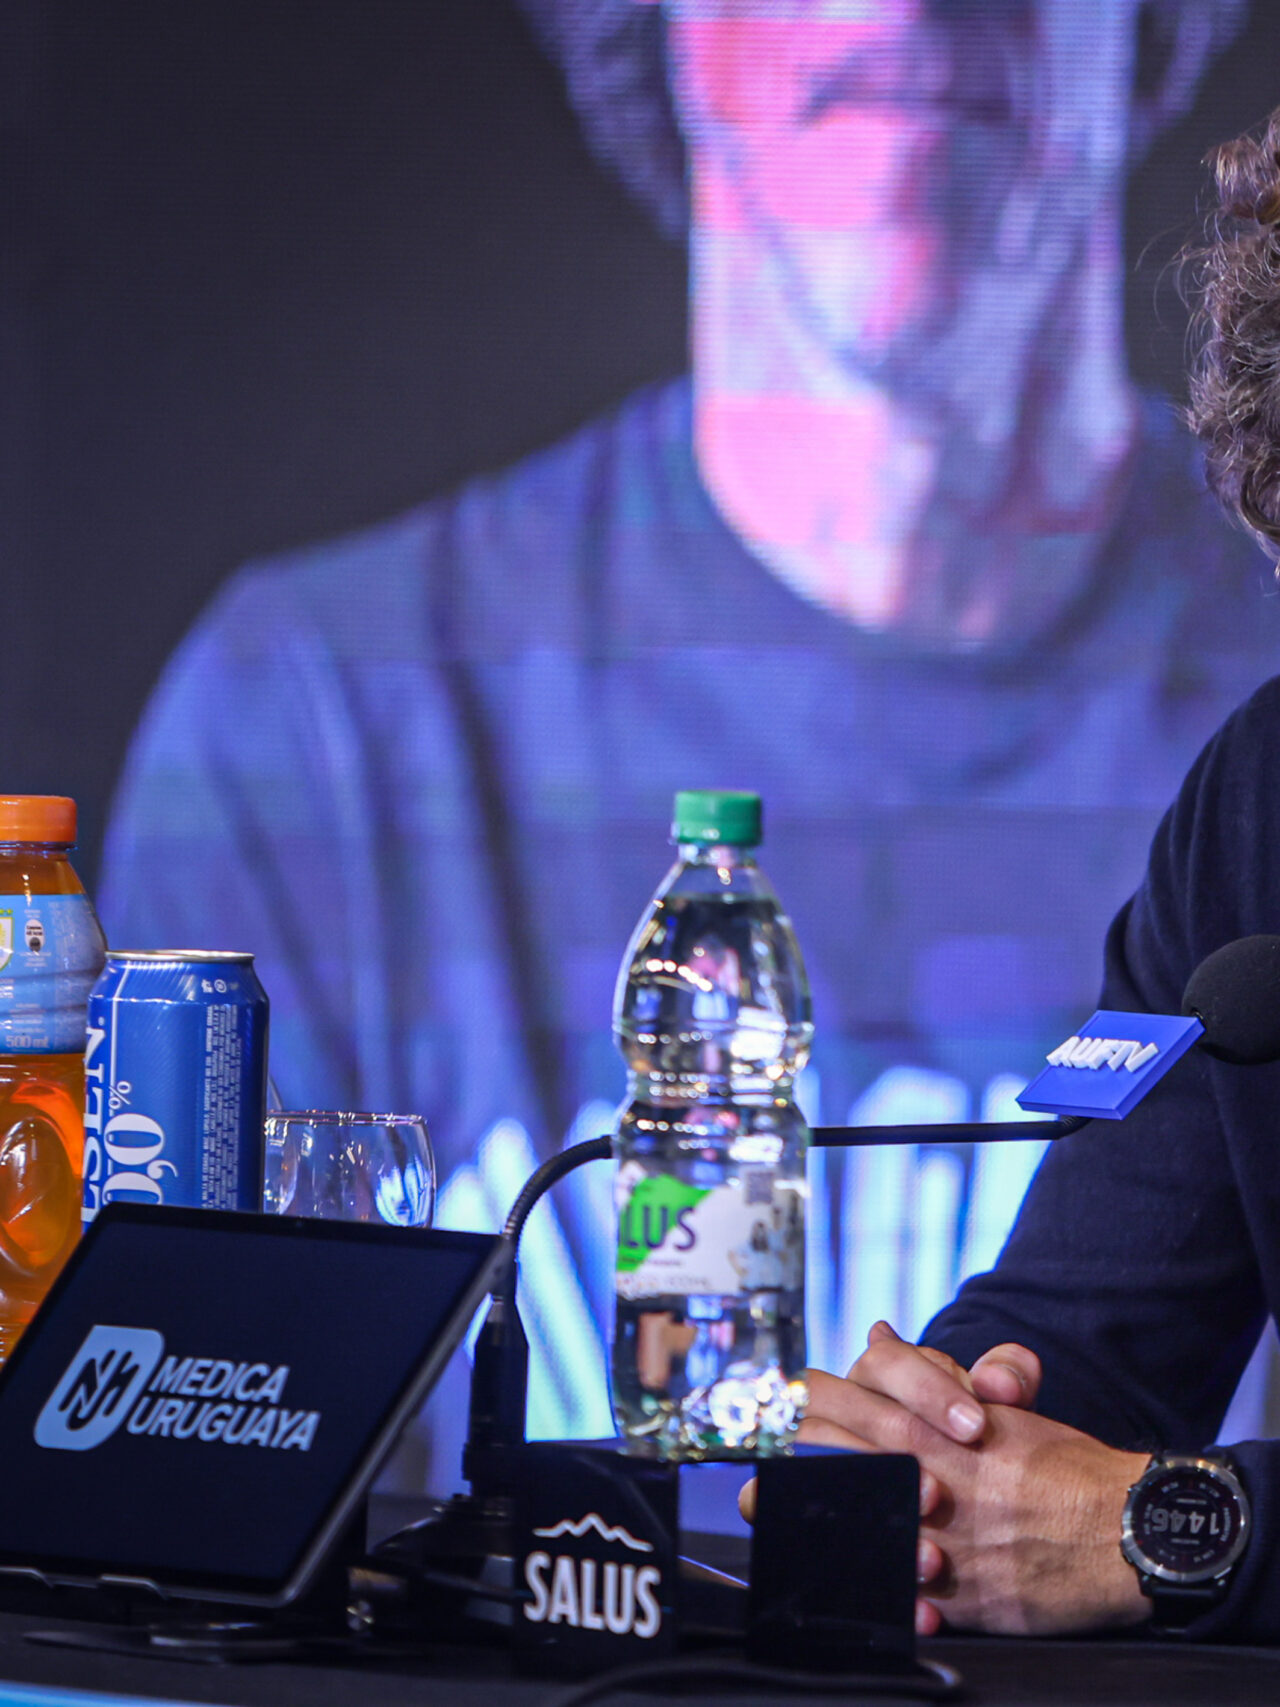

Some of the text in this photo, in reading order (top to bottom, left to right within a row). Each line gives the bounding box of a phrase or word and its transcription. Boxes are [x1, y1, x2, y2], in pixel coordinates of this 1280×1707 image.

[1046, 1036, 1159, 1073] AUFTV
[147, 1355, 290, 1403] MEDICA
[126, 1397, 321, 1451] URUGUAYA
[523, 1551, 662, 1639] SALUS
